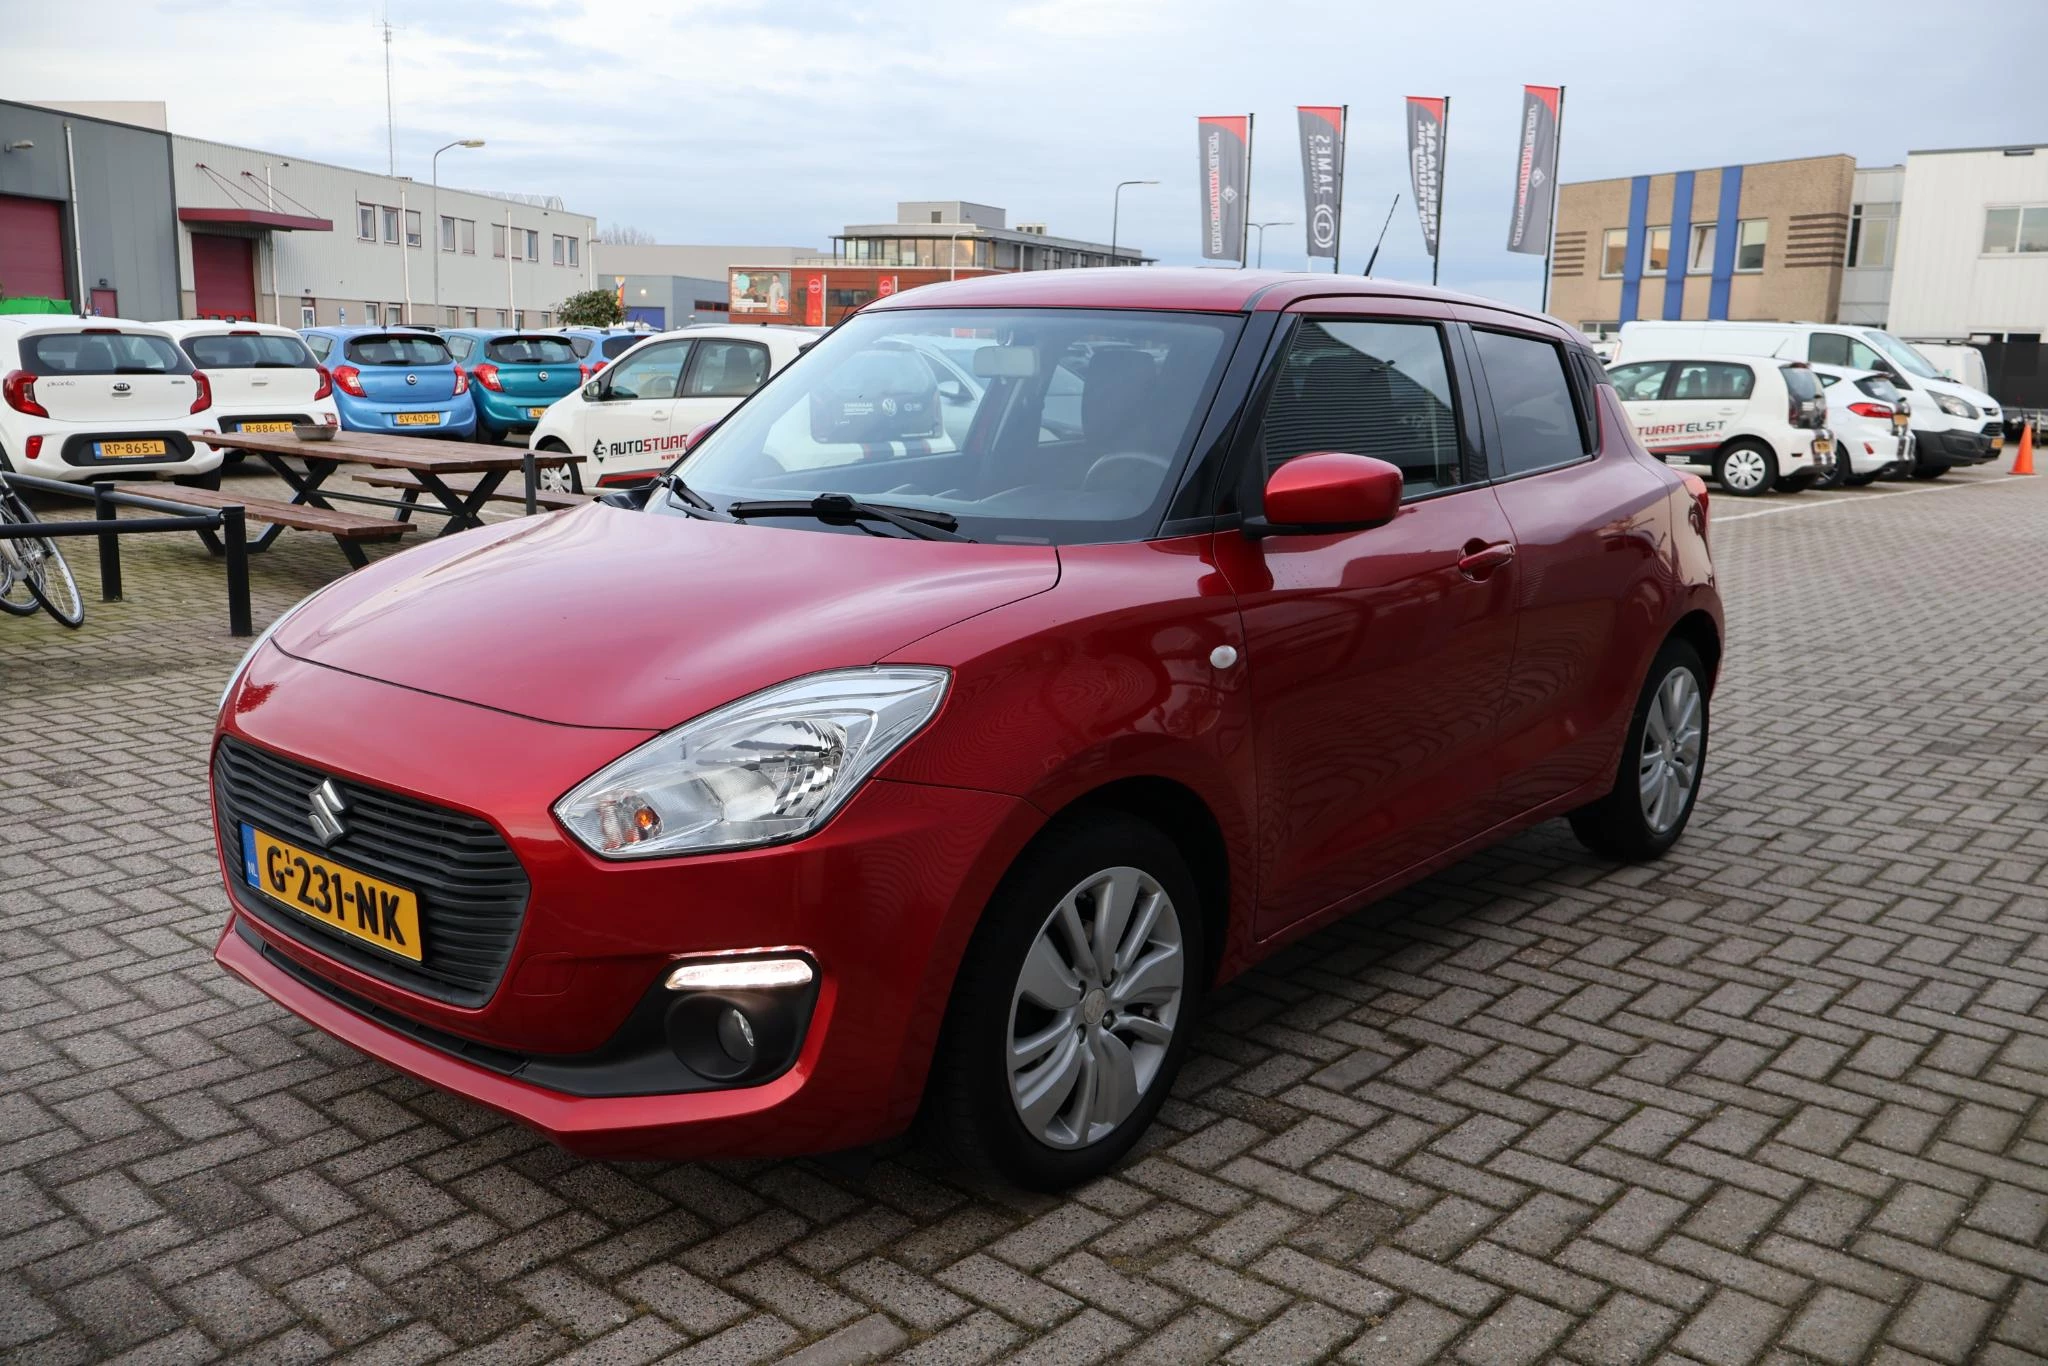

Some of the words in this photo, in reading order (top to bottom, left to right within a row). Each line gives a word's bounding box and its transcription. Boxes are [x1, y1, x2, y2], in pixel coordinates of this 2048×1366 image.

[399, 415, 436, 423] SV-400-P
[104, 441, 161, 454] RP-865-L
[267, 846, 406, 945] G-231-NK
